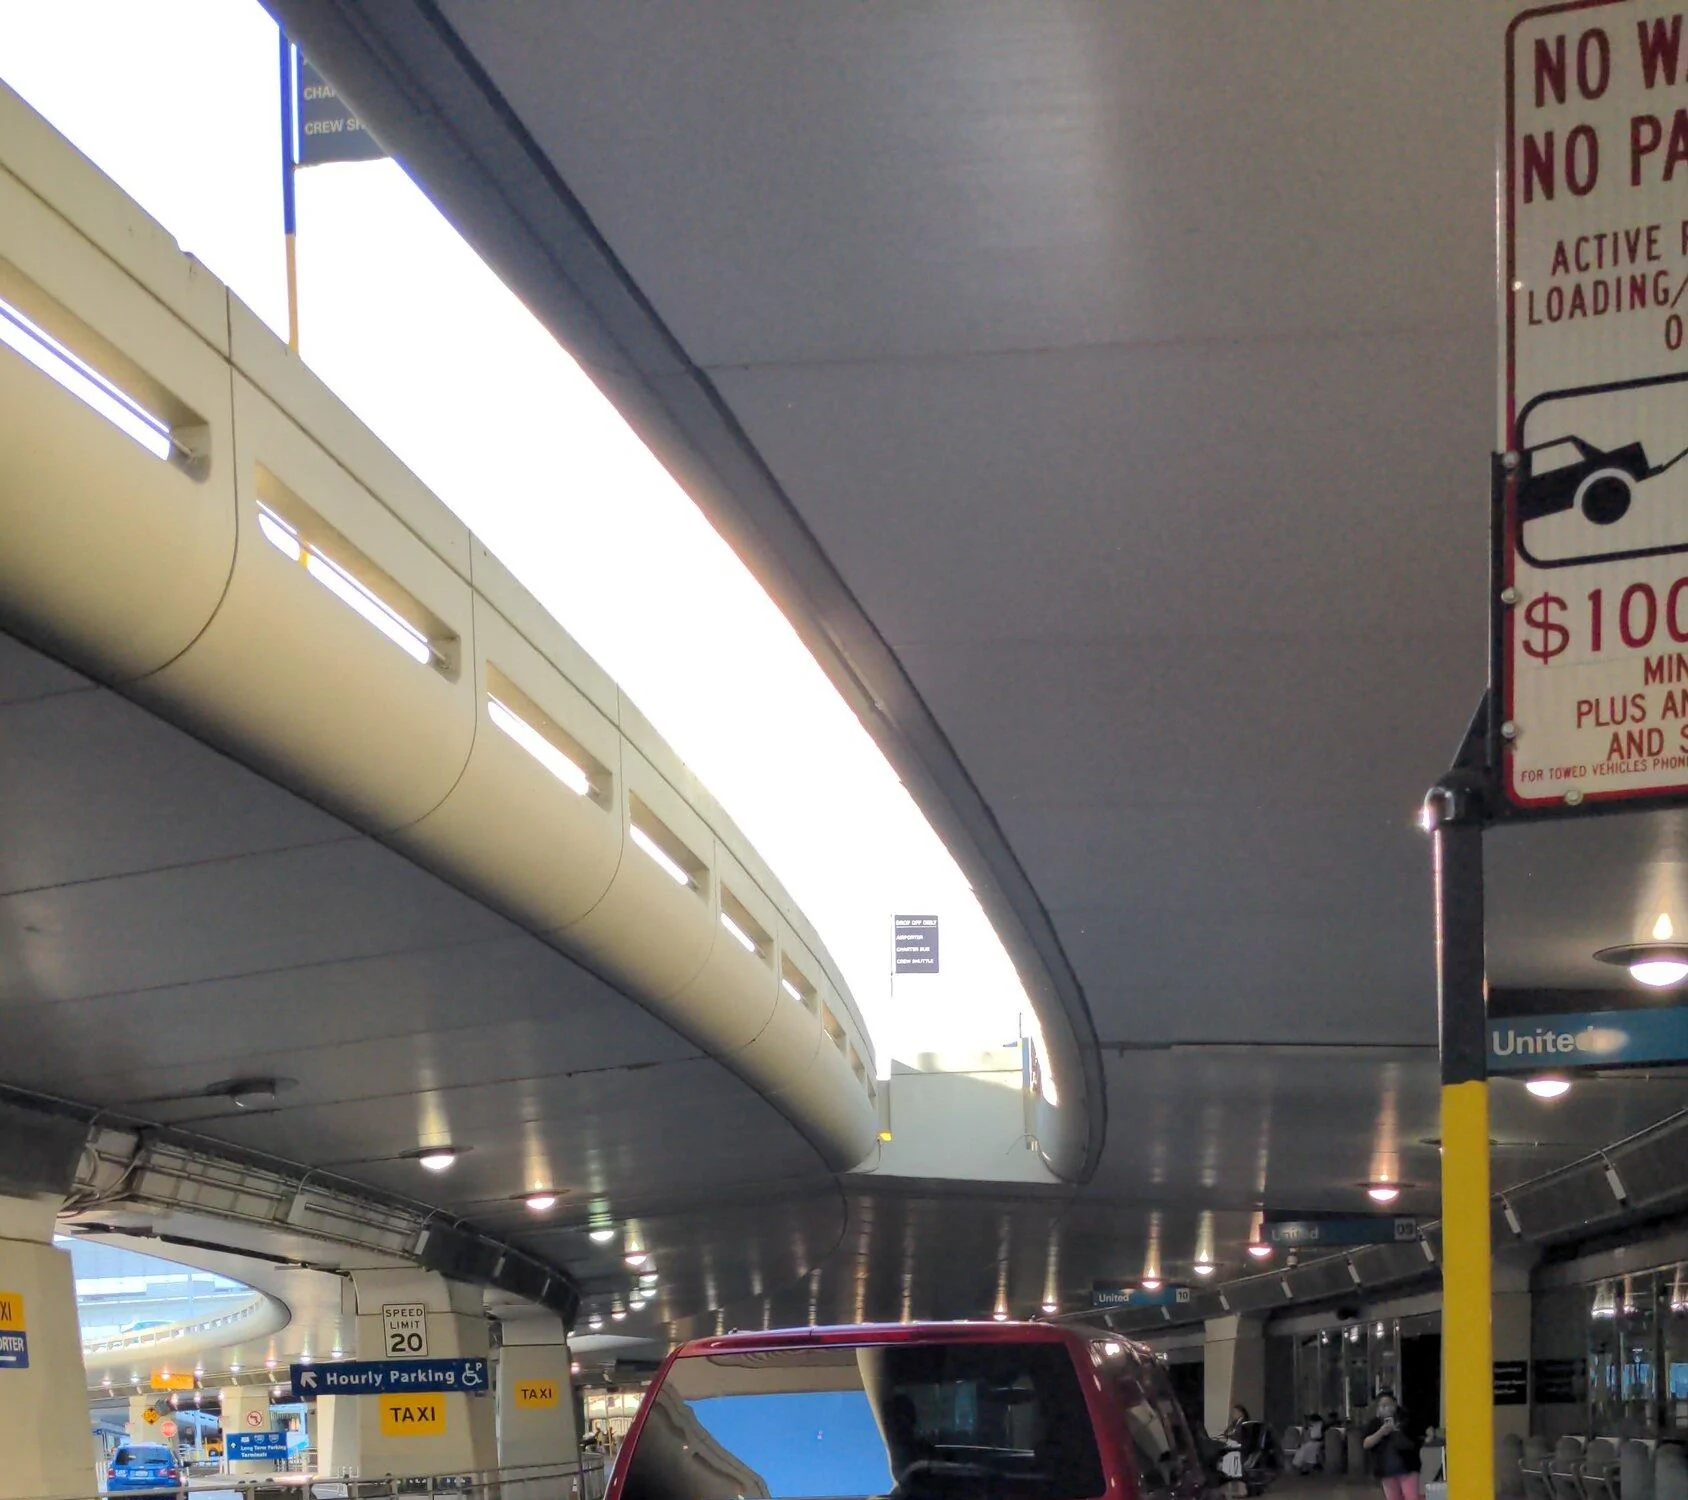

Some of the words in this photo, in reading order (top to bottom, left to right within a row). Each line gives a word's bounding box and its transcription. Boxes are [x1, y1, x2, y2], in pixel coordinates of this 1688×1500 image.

[1534, 28, 1611, 108] NO
[1637, 14, 1688, 89] W
[305, 119, 343, 135] CREW
[1523, 124, 1599, 204] NO
[1551, 224, 1662, 276] ACTIVE
[1576, 692, 1647, 729] PLUS
[1607, 728, 1664, 762] AND
[1521, 769, 1543, 783] FOR
[1550, 765, 1587, 780] TOWED
[1592, 759, 1648, 776] VEHICLES
[1653, 755, 1688, 771] PHON
[1492, 1025, 1594, 1056] United
[385, 1308, 423, 1318] SPEED
[390, 1320, 420, 1330] LIMIT
[390, 1333, 423, 1352] 20
[326, 1371, 383, 1386] Hourly
[390, 1369, 455, 1387] Parking
[521, 1388, 552, 1399] TAXI
[390, 1407, 436, 1422] TAXI
